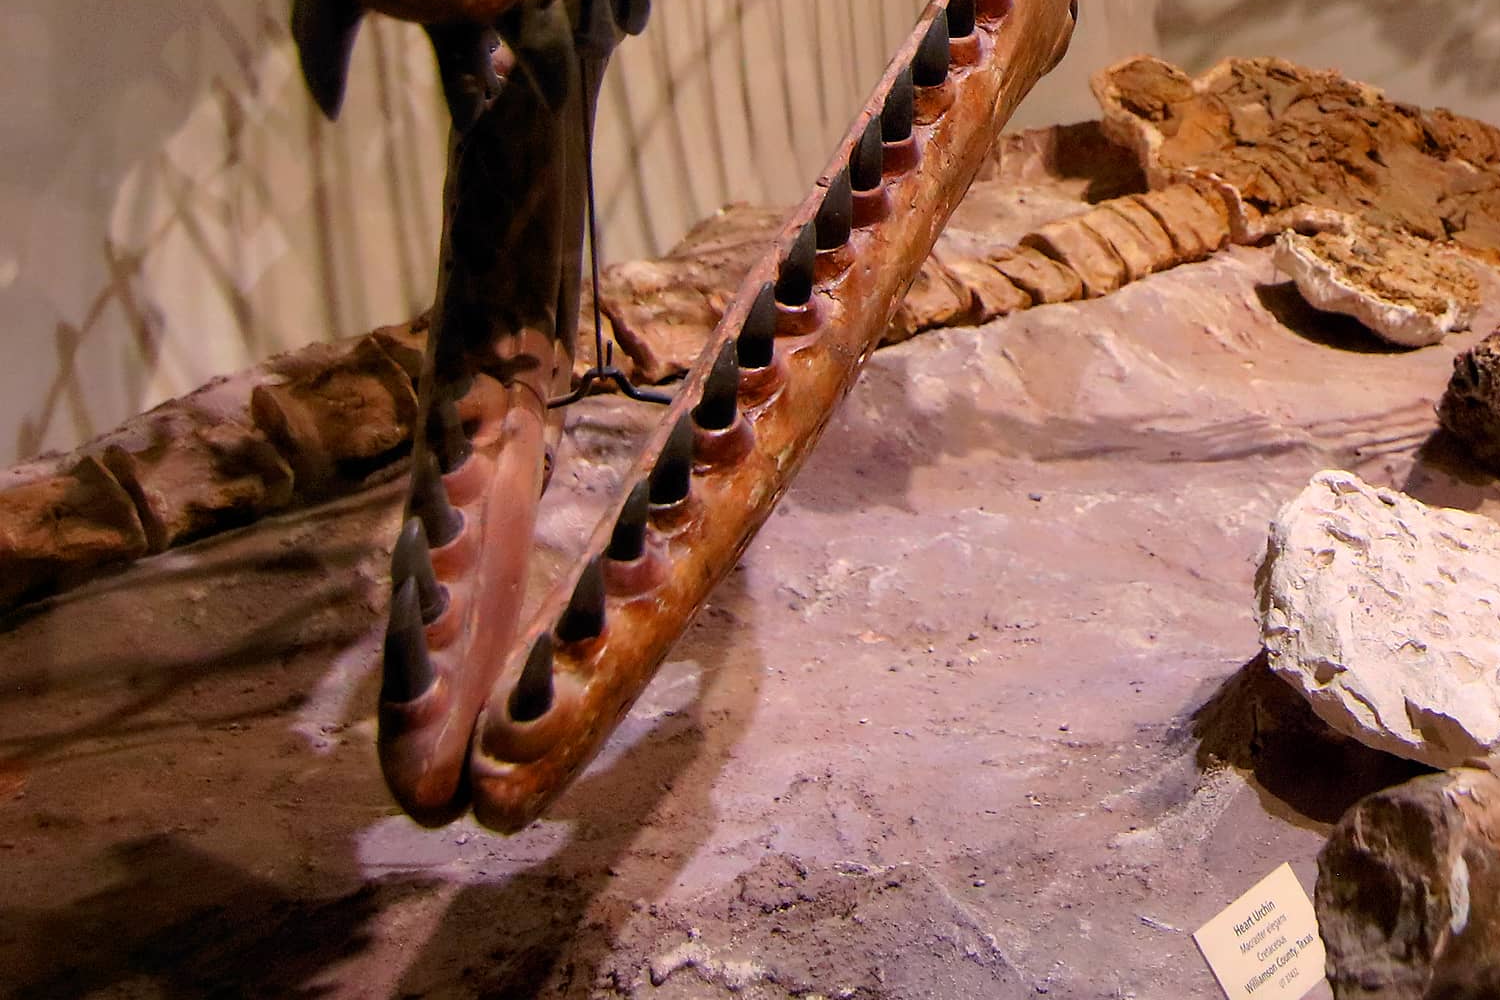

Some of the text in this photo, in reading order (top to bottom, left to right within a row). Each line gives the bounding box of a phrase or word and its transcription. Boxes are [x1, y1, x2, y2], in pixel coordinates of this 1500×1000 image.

[1233, 901, 1276, 936] Heart Urchin
[1244, 933, 1314, 994] Williamson County, Texas
[1257, 935, 1288, 962] Cretaceous
